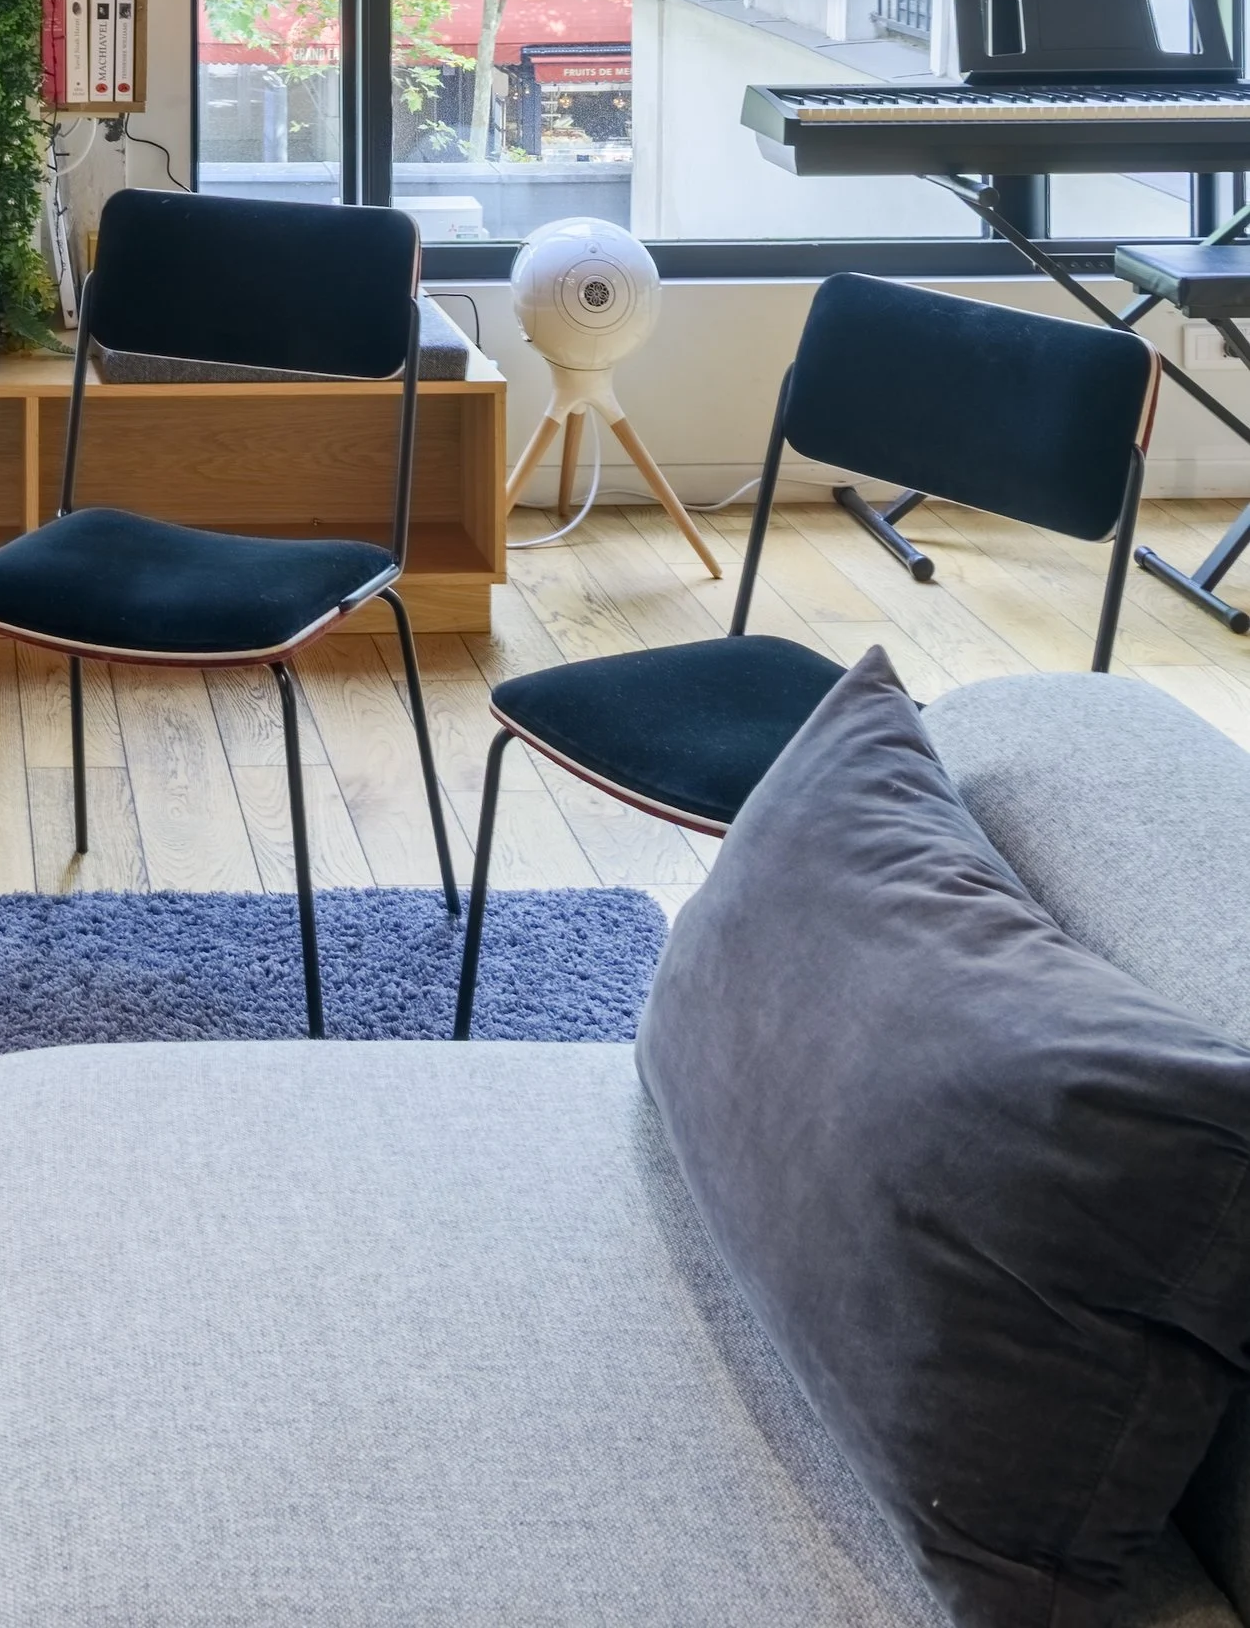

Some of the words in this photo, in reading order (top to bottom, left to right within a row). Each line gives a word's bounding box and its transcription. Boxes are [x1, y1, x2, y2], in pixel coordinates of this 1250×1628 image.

[98, 21, 107, 81] MACHIAVEL
[293, 47, 324, 61] GRAND
[327, 47, 340, 61] CA
